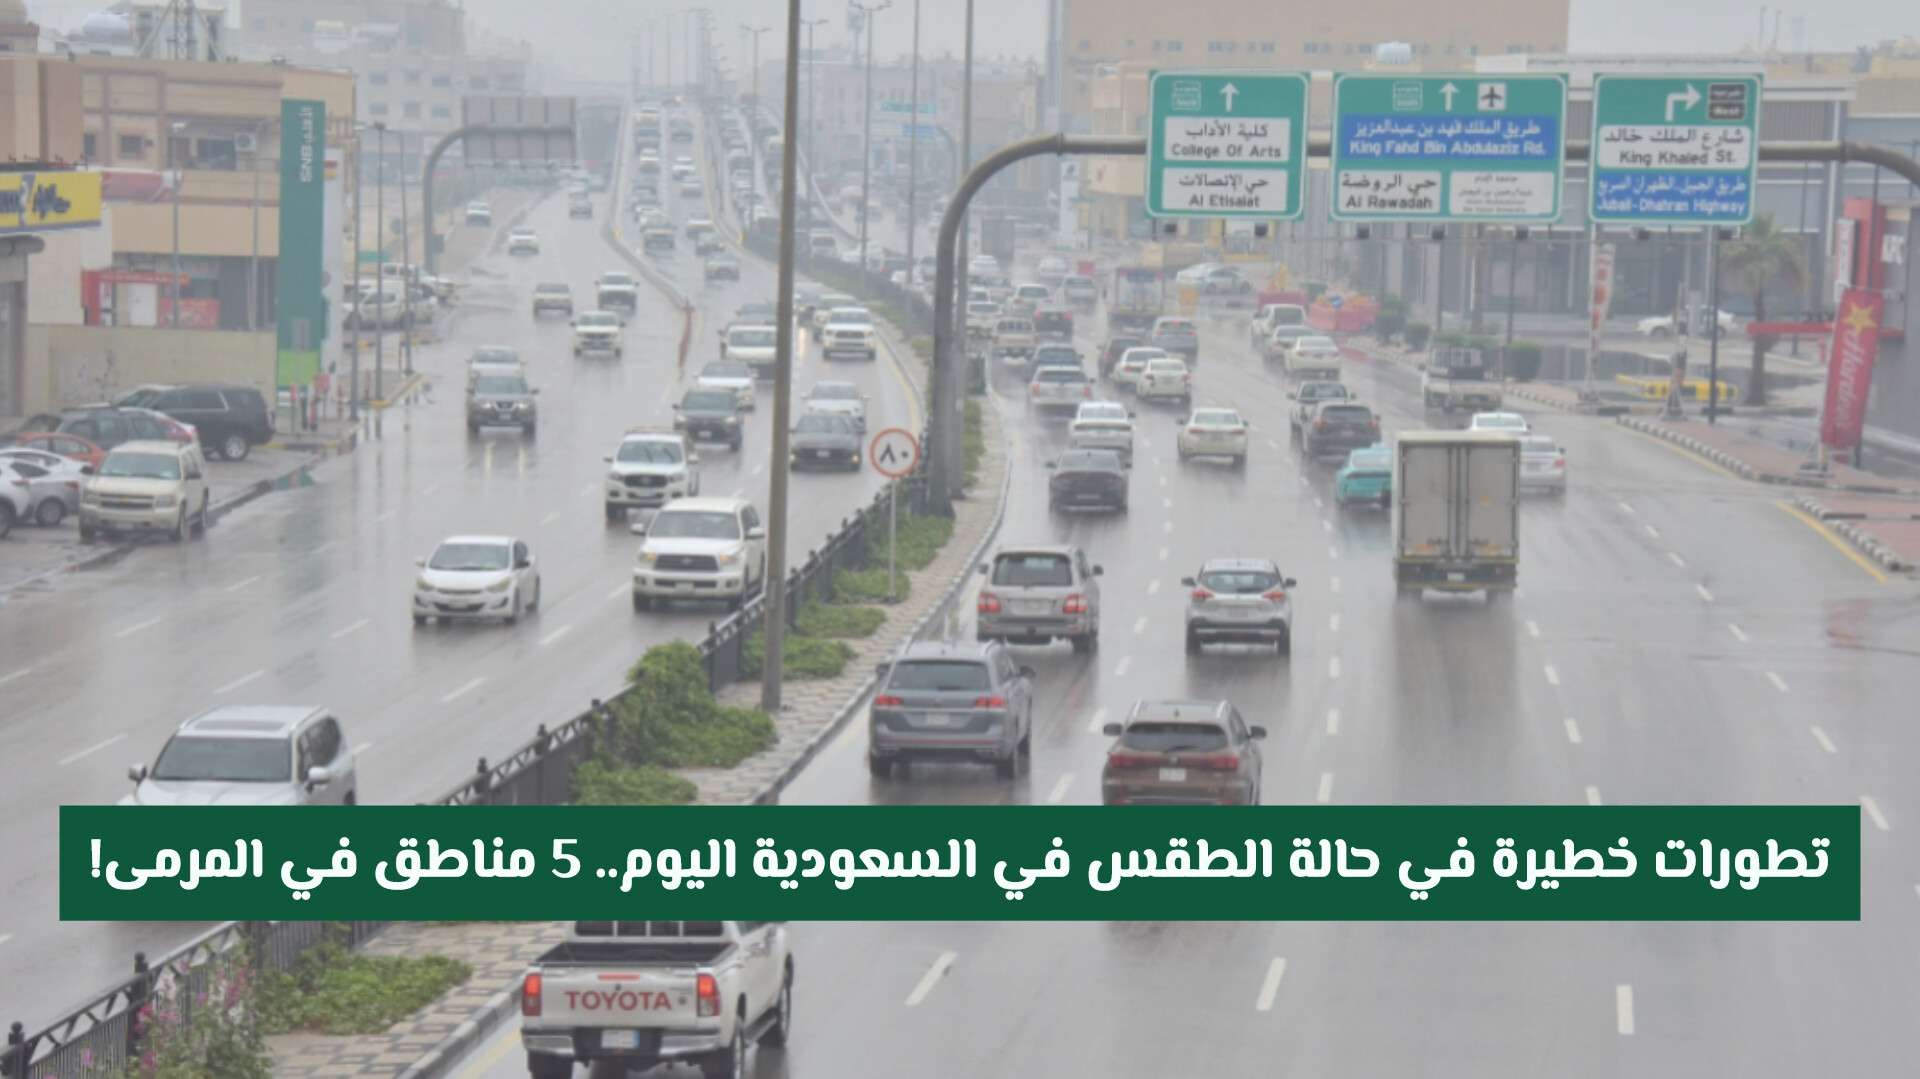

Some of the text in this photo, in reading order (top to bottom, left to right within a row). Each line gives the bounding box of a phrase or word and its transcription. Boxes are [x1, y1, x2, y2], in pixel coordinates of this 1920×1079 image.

[1237, 121, 1269, 141] كلية
[1417, 121, 1434, 138] بن
[1438, 119, 1462, 138] فهد
[1464, 118, 1500, 135] الملك
[1502, 119, 1541, 139] طريق
[1604, 128, 1744, 150] شارع الملك خالد
[1171, 143, 1281, 159] College Of Arts
[1349, 140, 1546, 157] King Fahd Bin Abdulaziz Rd.
[300, 145, 313, 183] SNB
[1619, 150, 1737, 167] King Khaled St.
[1245, 178, 1269, 194] حي
[1342, 172, 1437, 196] حي الروضة
[1189, 194, 1260, 208] Al Etisalat
[1346, 194, 1433, 209] Al Rawadah
[1693, 198, 1746, 216] Highway
[564, 991, 672, 1010] TOYOTA
